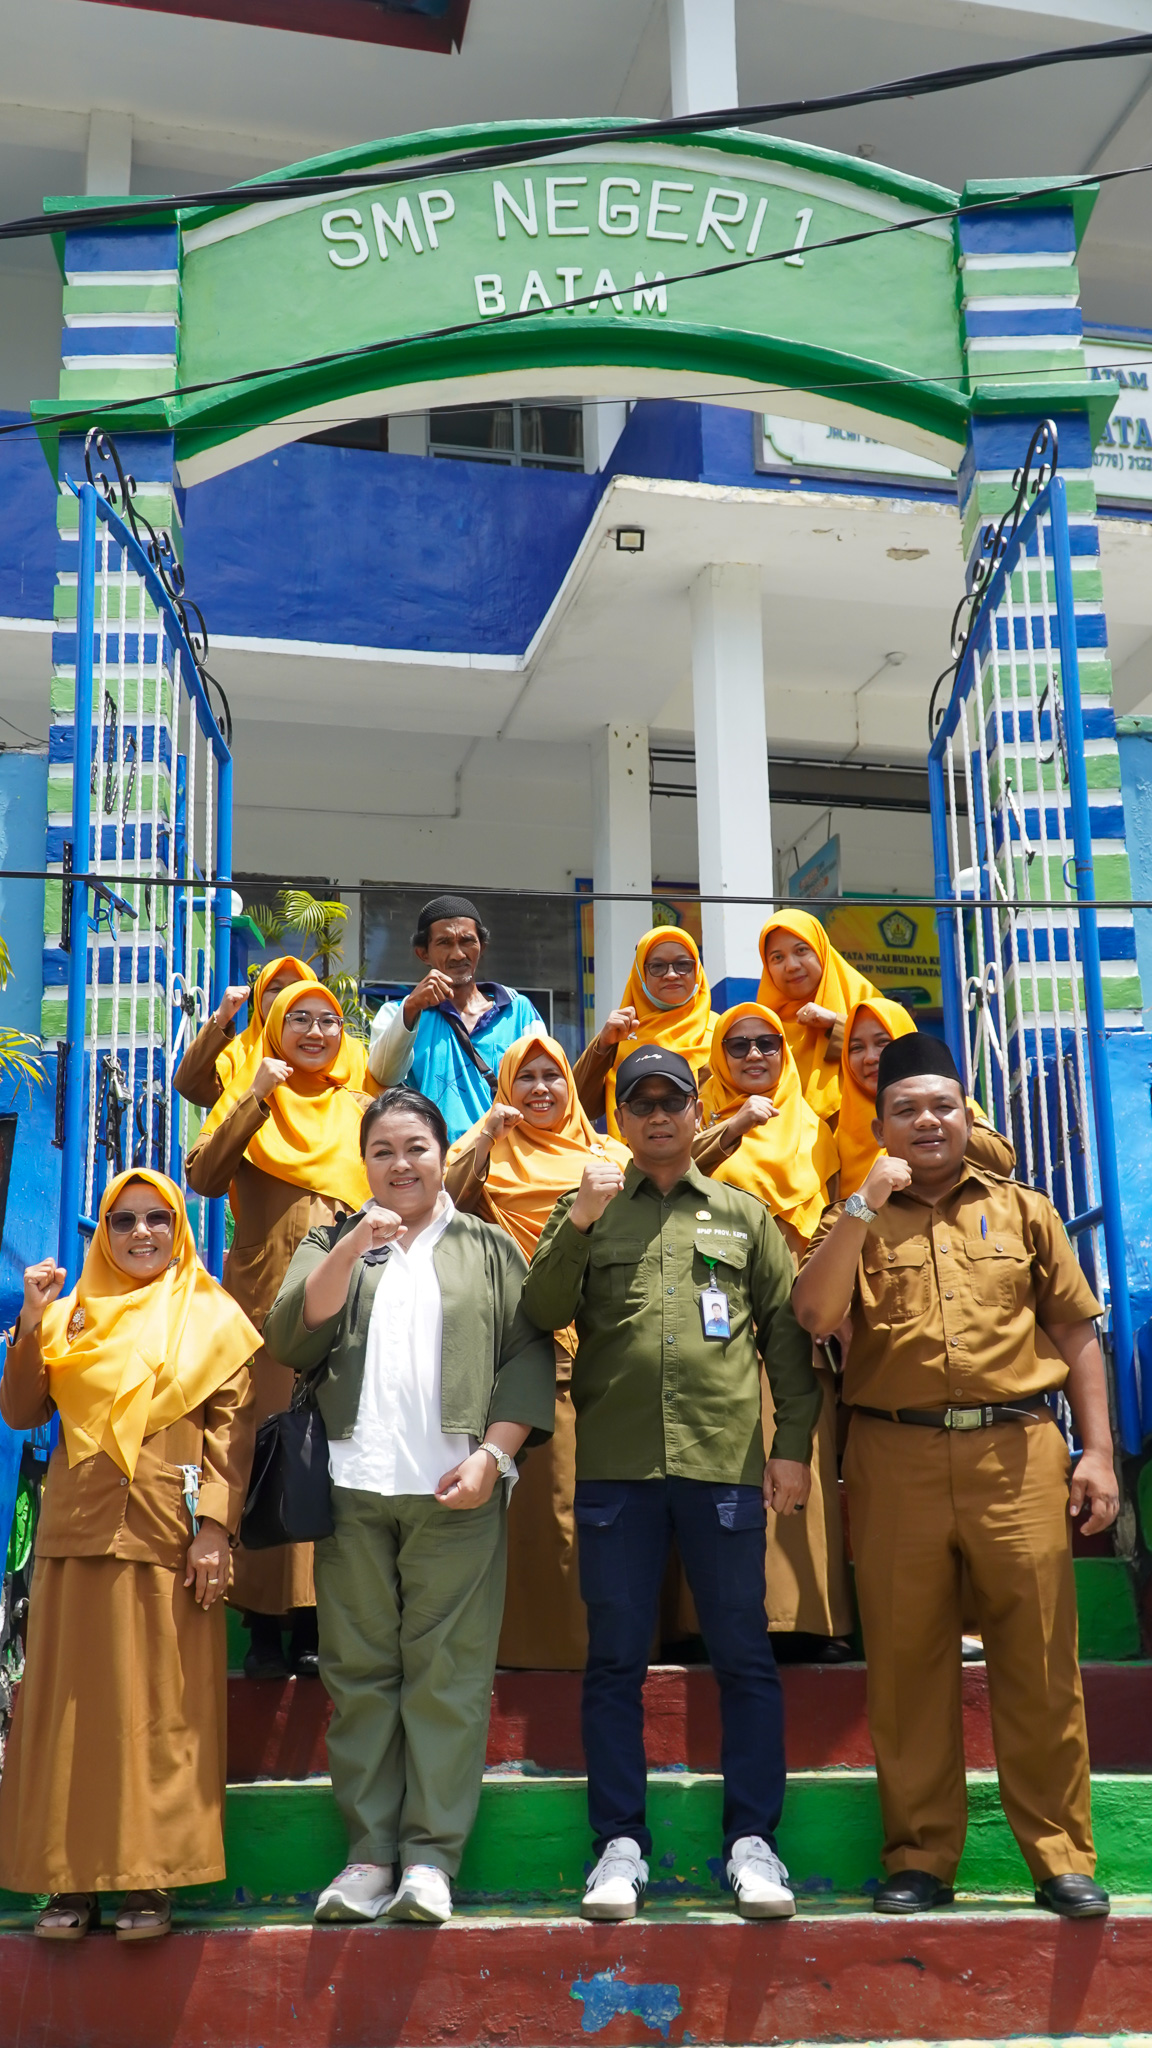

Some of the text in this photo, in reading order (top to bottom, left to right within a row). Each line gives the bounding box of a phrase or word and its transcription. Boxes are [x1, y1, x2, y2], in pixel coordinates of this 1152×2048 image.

[321, 176, 813, 269] SMP NEGERI 1
[474, 266, 668, 317] BATAM
[856, 964, 873, 974] SMP
[876, 965, 908, 976] NEGERI
[917, 967, 941, 977] BATA
[866, 952, 890, 963] NILAI
[892, 954, 927, 965] BUDAYA
